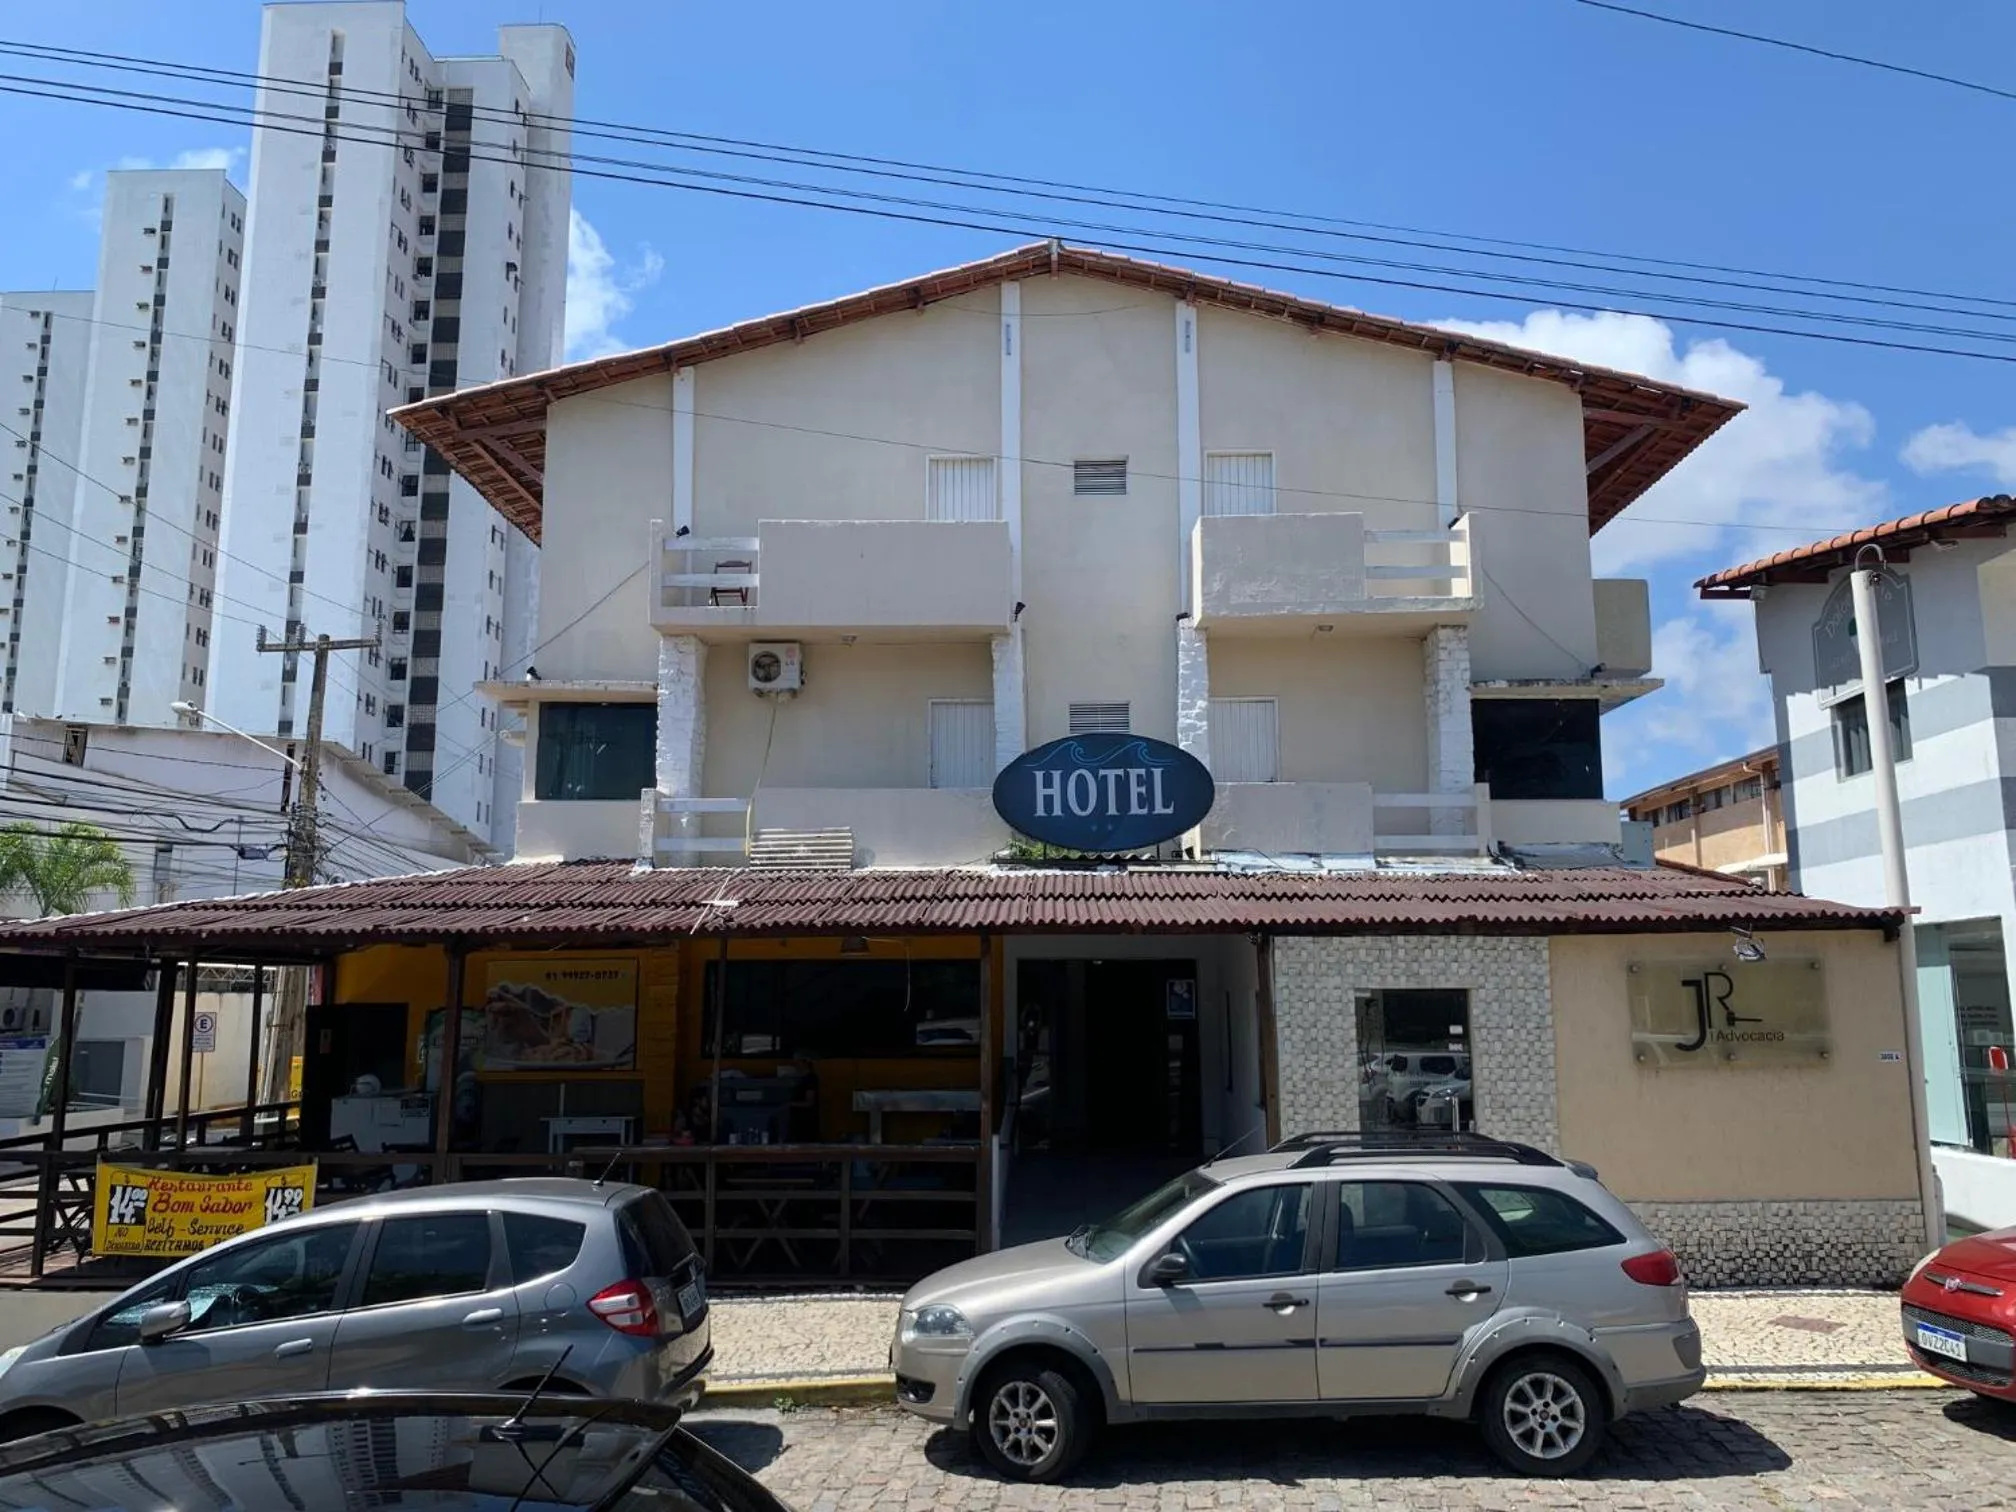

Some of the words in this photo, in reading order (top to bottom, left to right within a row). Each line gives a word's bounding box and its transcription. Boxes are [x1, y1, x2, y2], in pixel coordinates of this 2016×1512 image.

[1033, 767, 1175, 817] HOTEL
[1675, 972, 1736, 1052] JR
[200, 1019, 208, 1029] E
[1716, 1029, 1785, 1042] Advocacia
[148, 1175, 253, 1193] Restaurante
[152, 1192, 195, 1213] Bom
[199, 1195, 253, 1214] Sabor
